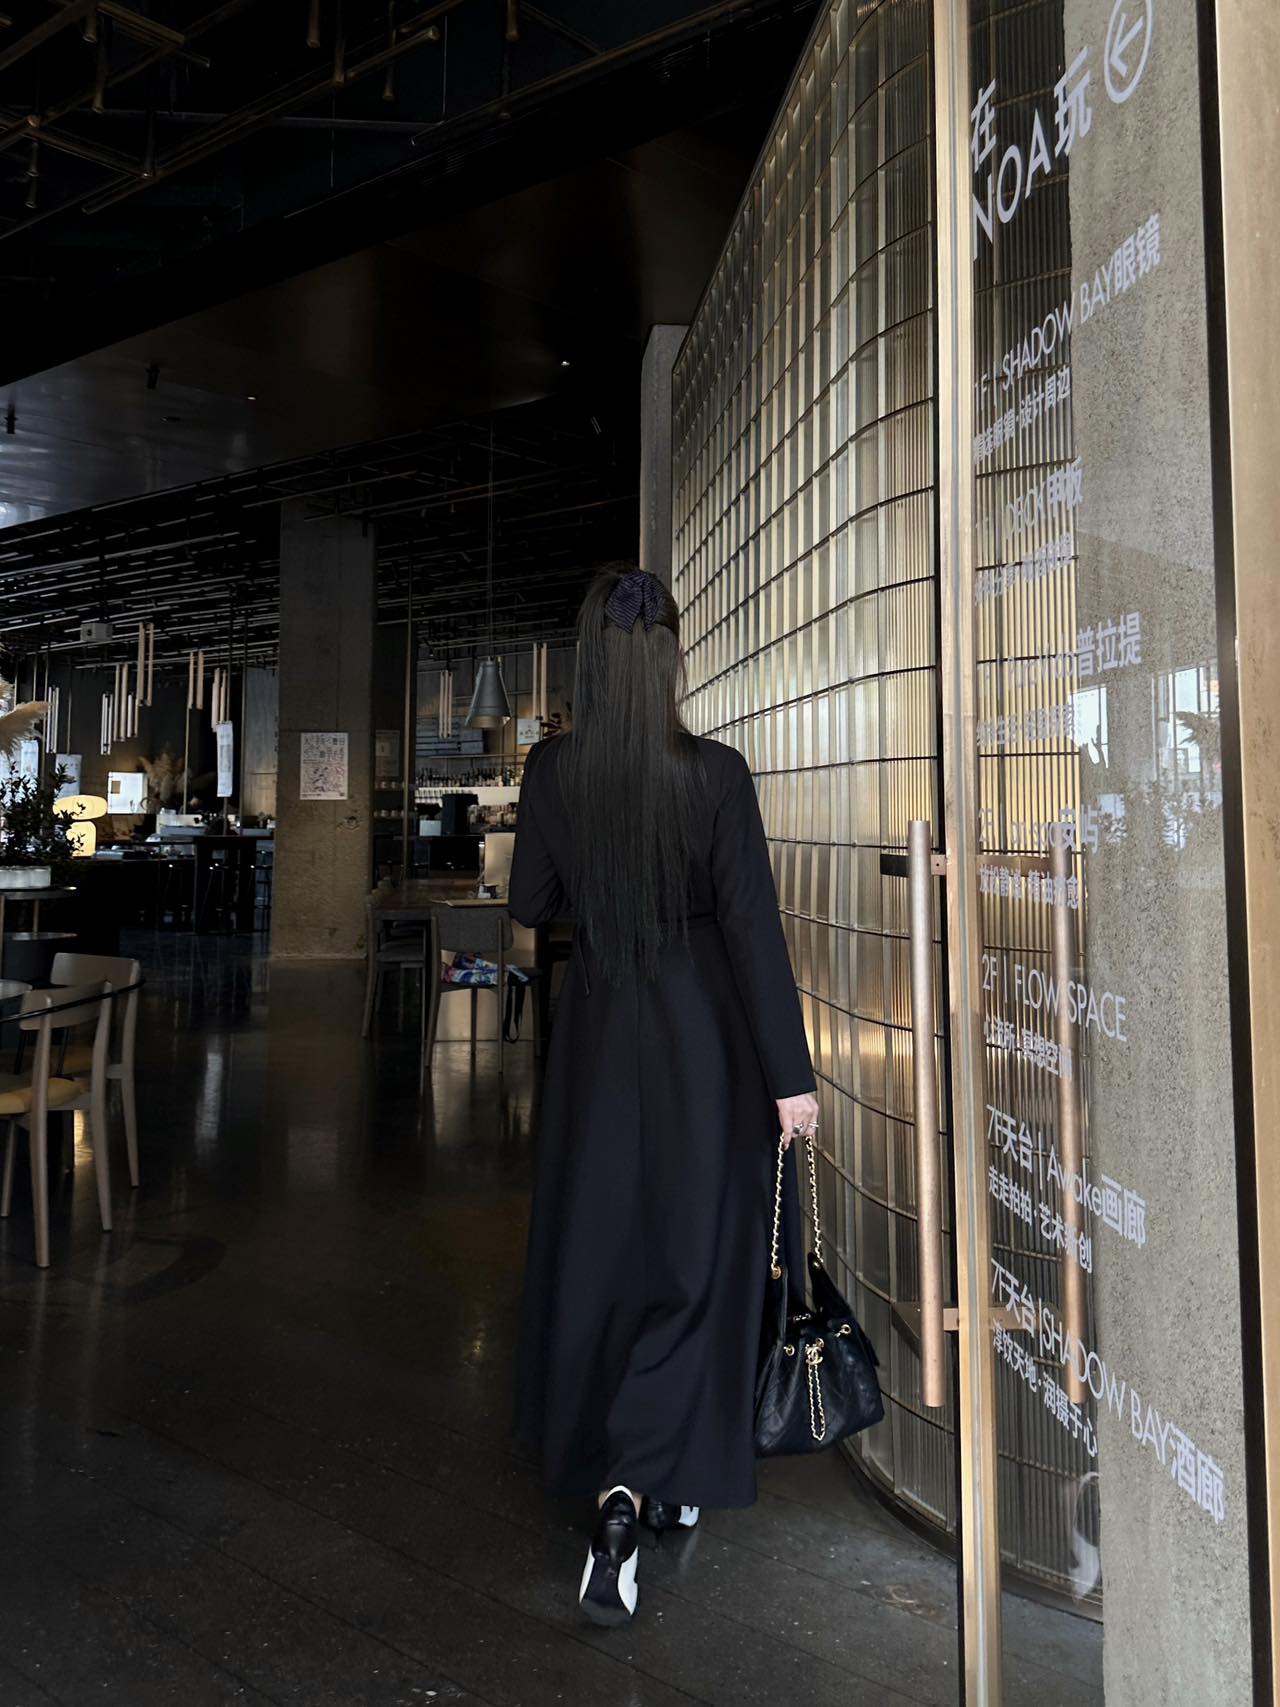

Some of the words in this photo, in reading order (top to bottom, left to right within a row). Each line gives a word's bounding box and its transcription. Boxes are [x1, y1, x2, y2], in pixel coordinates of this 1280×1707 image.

[971, 79, 997, 173] 在
[1003, 291, 1075, 391] SHADOW
[982, 953, 998, 992] 2F
[1014, 964, 1062, 1017] FLOW
[1067, 980, 1127, 1042] SPACE
[1043, 1307, 1126, 1421] SHADOW
